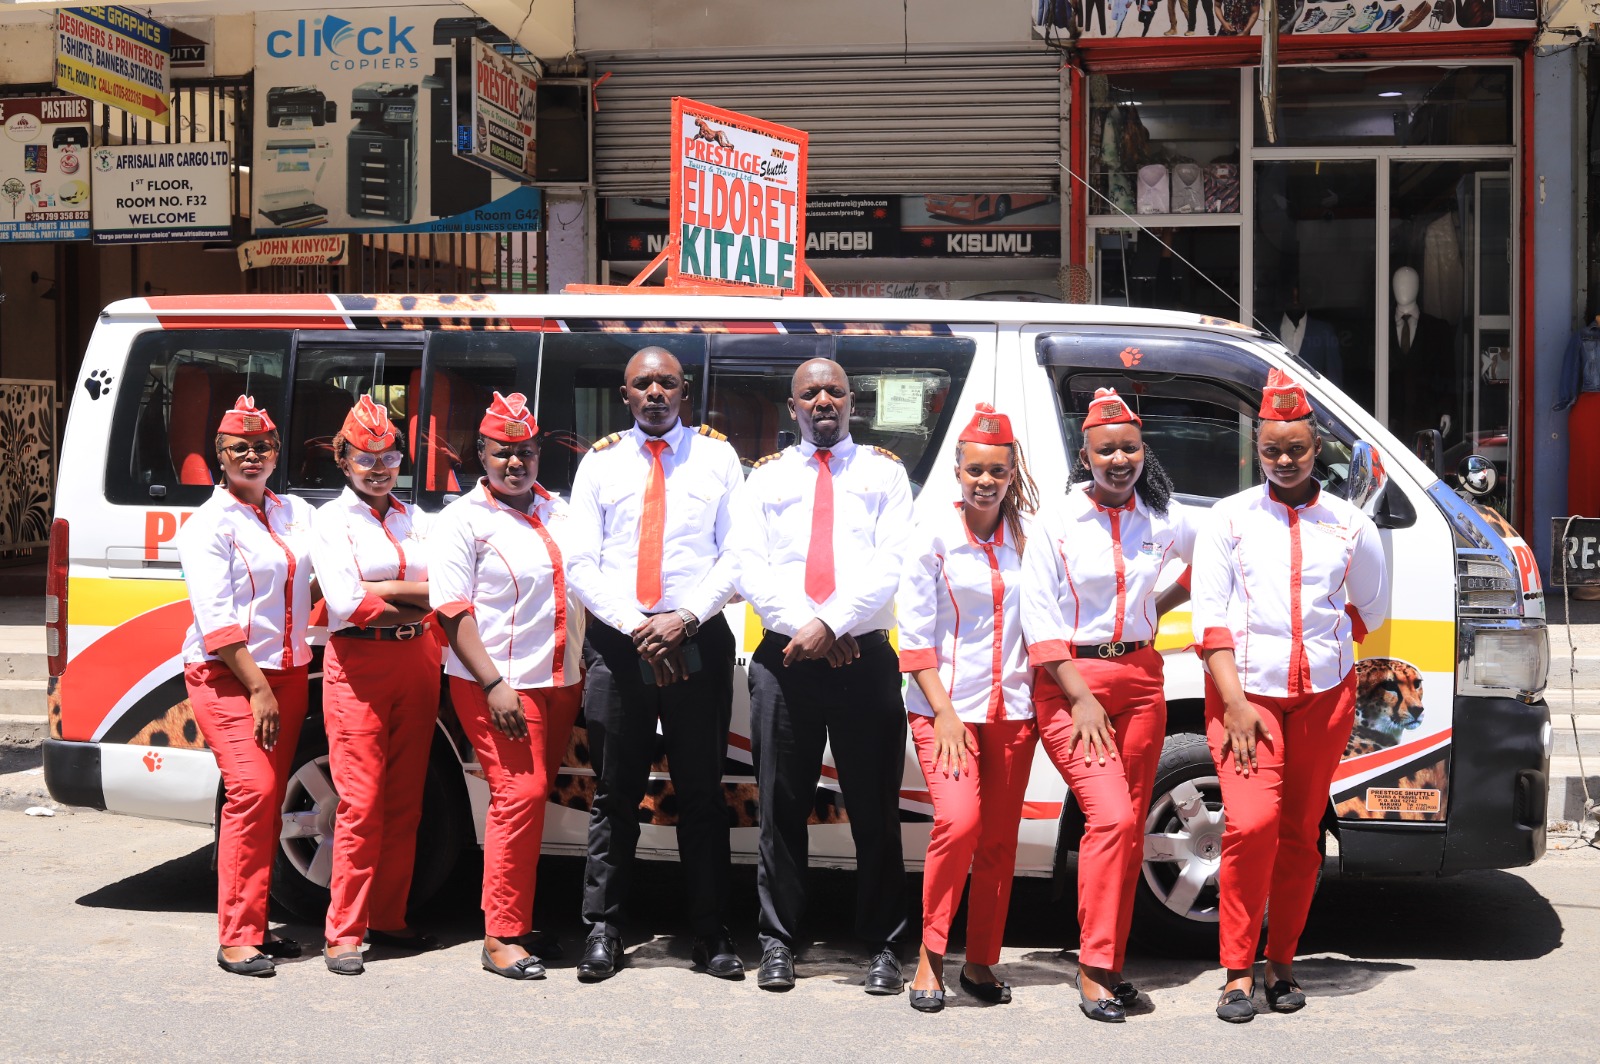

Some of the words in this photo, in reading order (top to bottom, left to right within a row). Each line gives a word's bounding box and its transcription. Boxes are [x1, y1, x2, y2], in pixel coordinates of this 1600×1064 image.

[107, 7, 161, 44] GRAPHICS
[59, 13, 106, 48] DESIGNERS
[107, 34, 114, 51] &
[115, 37, 153, 67] PRINTERS
[154, 53, 165, 71] OF
[60, 34, 94, 68] T-SHIRTS,
[170, 48, 201, 59] UITY
[330, 58, 419, 70] COPIERS
[75, 69, 90, 87] ROOM
[98, 78, 113, 95] CALL:
[477, 60, 519, 115] PRESTIGE
[41, 99, 88, 119] PASTRIES
[489, 123, 509, 140] BOOKING
[509, 132, 524, 148] OFFICE
[116, 153, 157, 170] AFRISALI
[158, 152, 175, 168] AIR
[176, 151, 209, 167] CARGO
[211, 151, 228, 166] LTD
[684, 136, 762, 175] PRESTIGE
[760, 160, 788, 177] Shuttle
[716, 168, 739, 178] Travel
[147, 179, 193, 191] FLOOR,
[116, 197, 155, 208] ROOM
[159, 196, 183, 207] NO.
[186, 195, 207, 206] F32
[683, 165, 796, 243] ELDORET
[75, 211, 89, 219] 828
[129, 212, 196, 225] WELCOME
[475, 210, 511, 221] Room
[515, 209, 540, 220] G42
[115, 232, 134, 240] partner
[431, 224, 463, 232] UCHUMI
[465, 223, 505, 231] BUSINESS
[256, 240, 288, 256] JOHN
[291, 237, 340, 254] KINYOZI
[805, 231, 873, 251] AIROBI
[947, 233, 1032, 253] KISUMU
[271, 256, 292, 265] 0720
[293, 255, 325, 265] 460976
[681, 224, 795, 289] KITALE
[886, 281, 920, 299] Shuttle
[1564, 536, 1600, 570] RE
